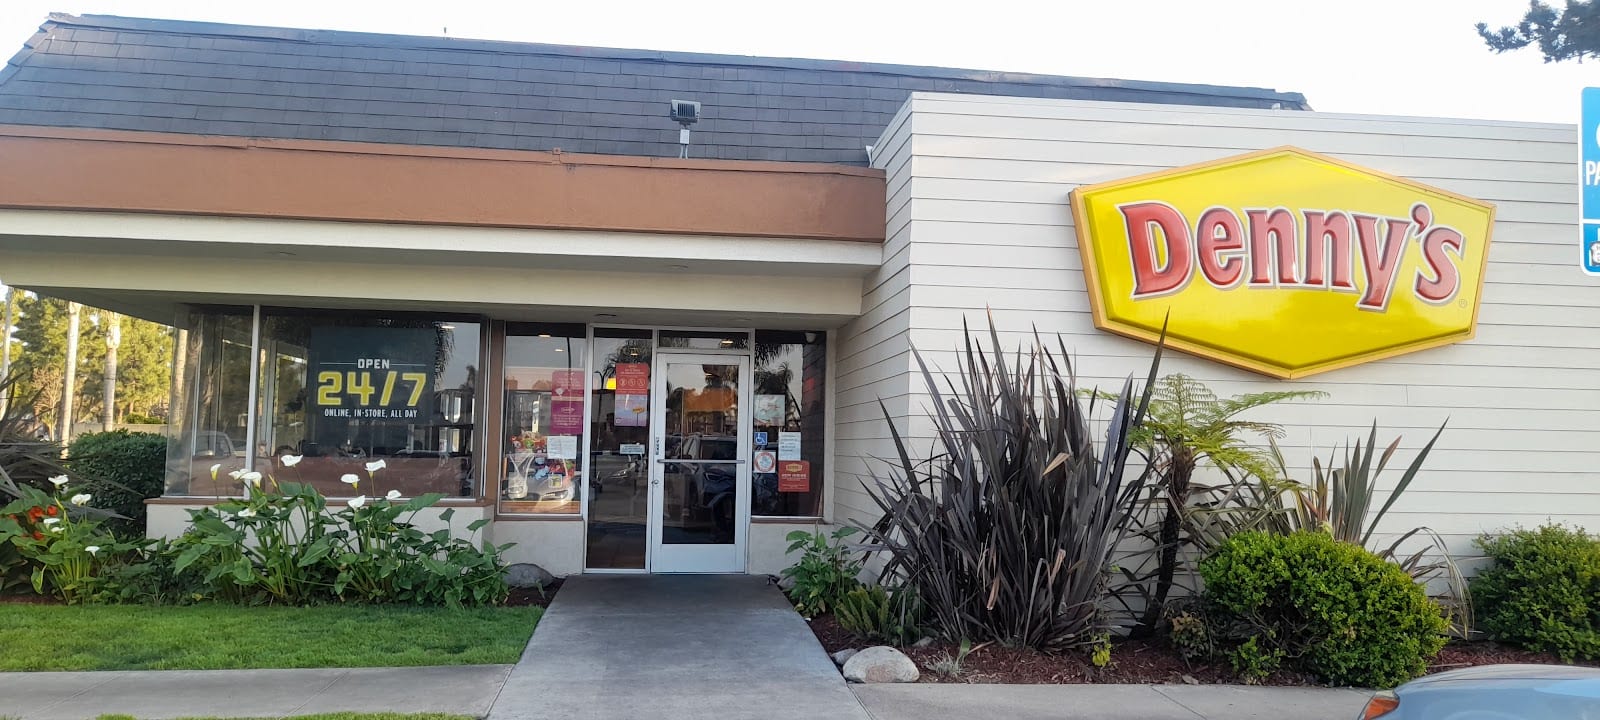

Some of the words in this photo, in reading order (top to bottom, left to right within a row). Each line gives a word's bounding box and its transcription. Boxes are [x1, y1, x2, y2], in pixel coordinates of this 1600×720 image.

[1118, 201, 1464, 309] Denny's
[358, 358, 390, 369] OPEN
[317, 371, 427, 406] 24/7
[324, 408, 352, 418] ONLINE,
[390, 409, 402, 418] ALL
[405, 409, 418, 418] DAY
